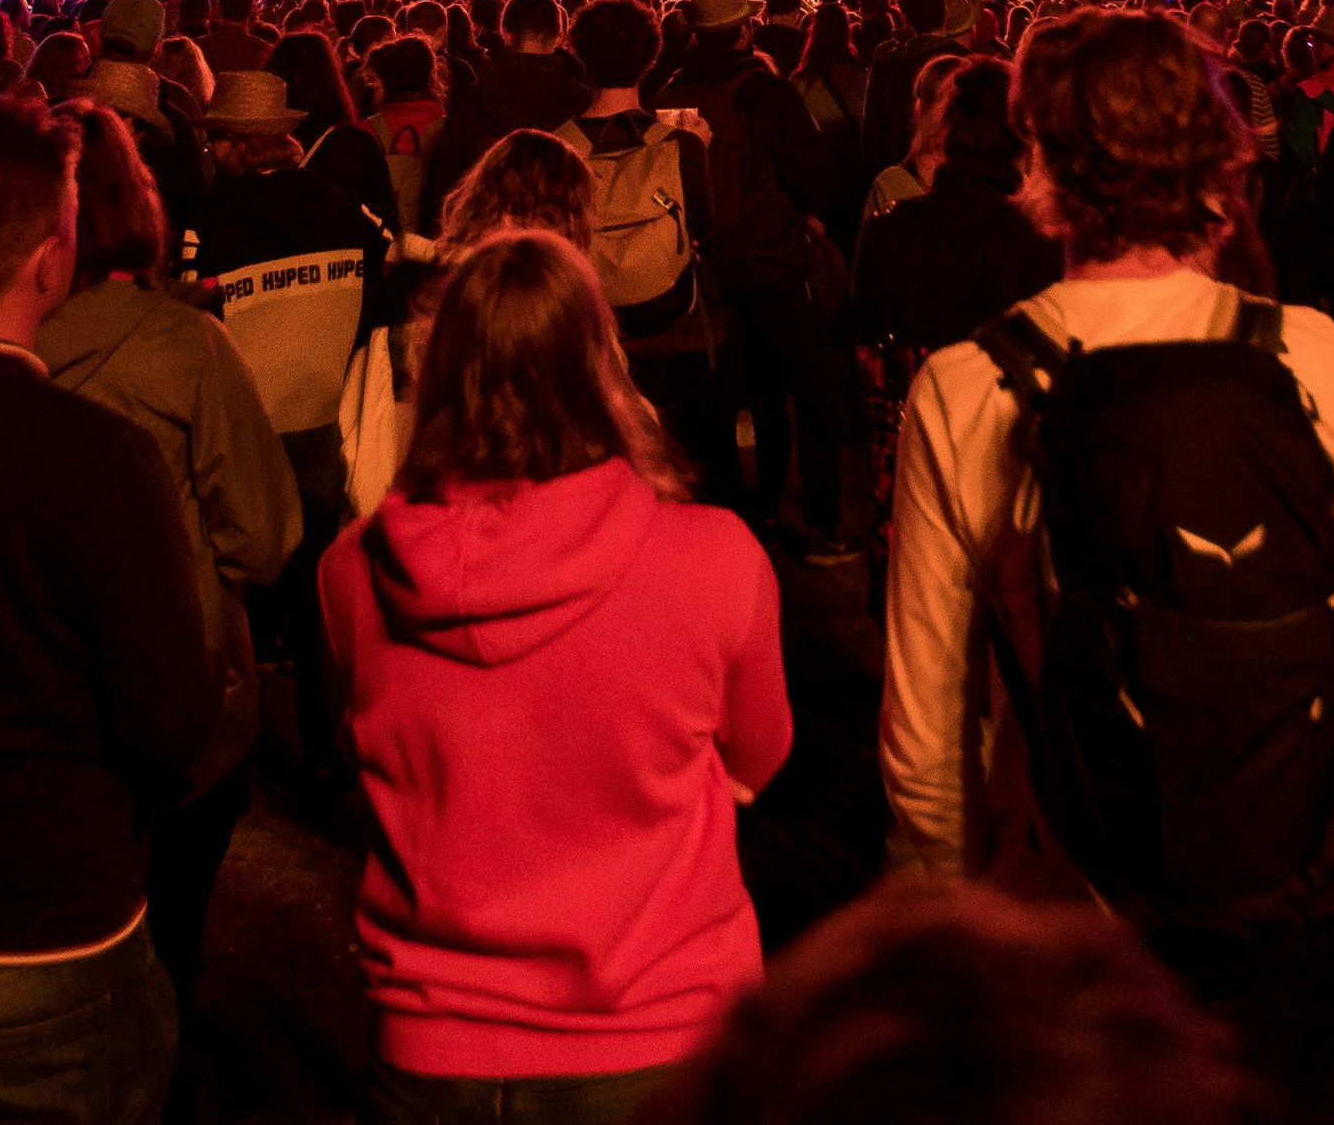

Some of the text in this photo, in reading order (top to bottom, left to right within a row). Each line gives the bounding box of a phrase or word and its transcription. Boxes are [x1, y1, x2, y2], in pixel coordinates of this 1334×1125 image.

[217, 259, 364, 303] PED HYPED HYPE
